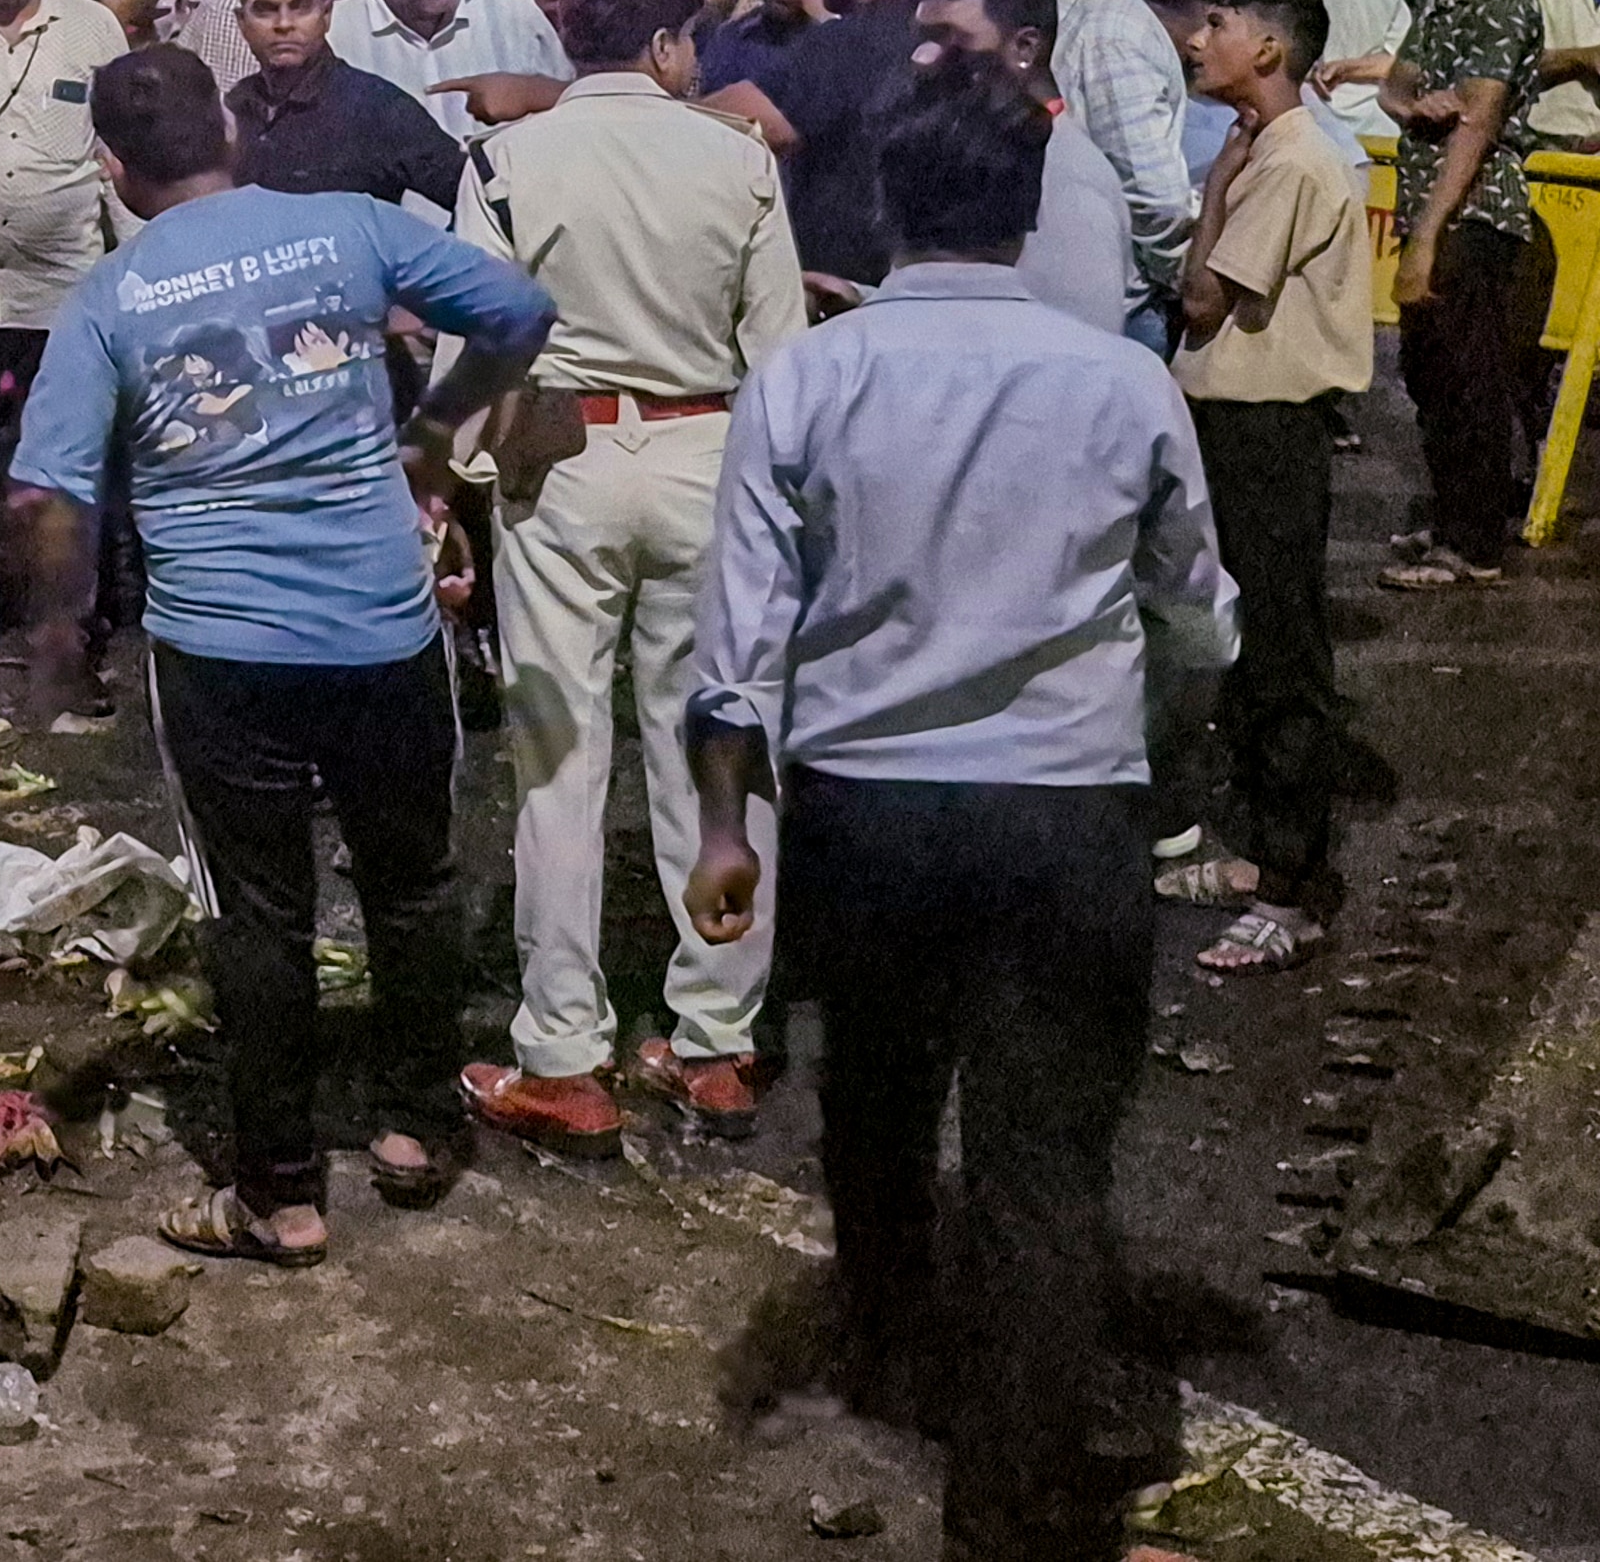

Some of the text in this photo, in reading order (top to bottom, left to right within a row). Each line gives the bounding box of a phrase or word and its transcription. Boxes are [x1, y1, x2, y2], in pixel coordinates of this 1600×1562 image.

[133, 235, 339, 314] MONKEY D LUFFY
